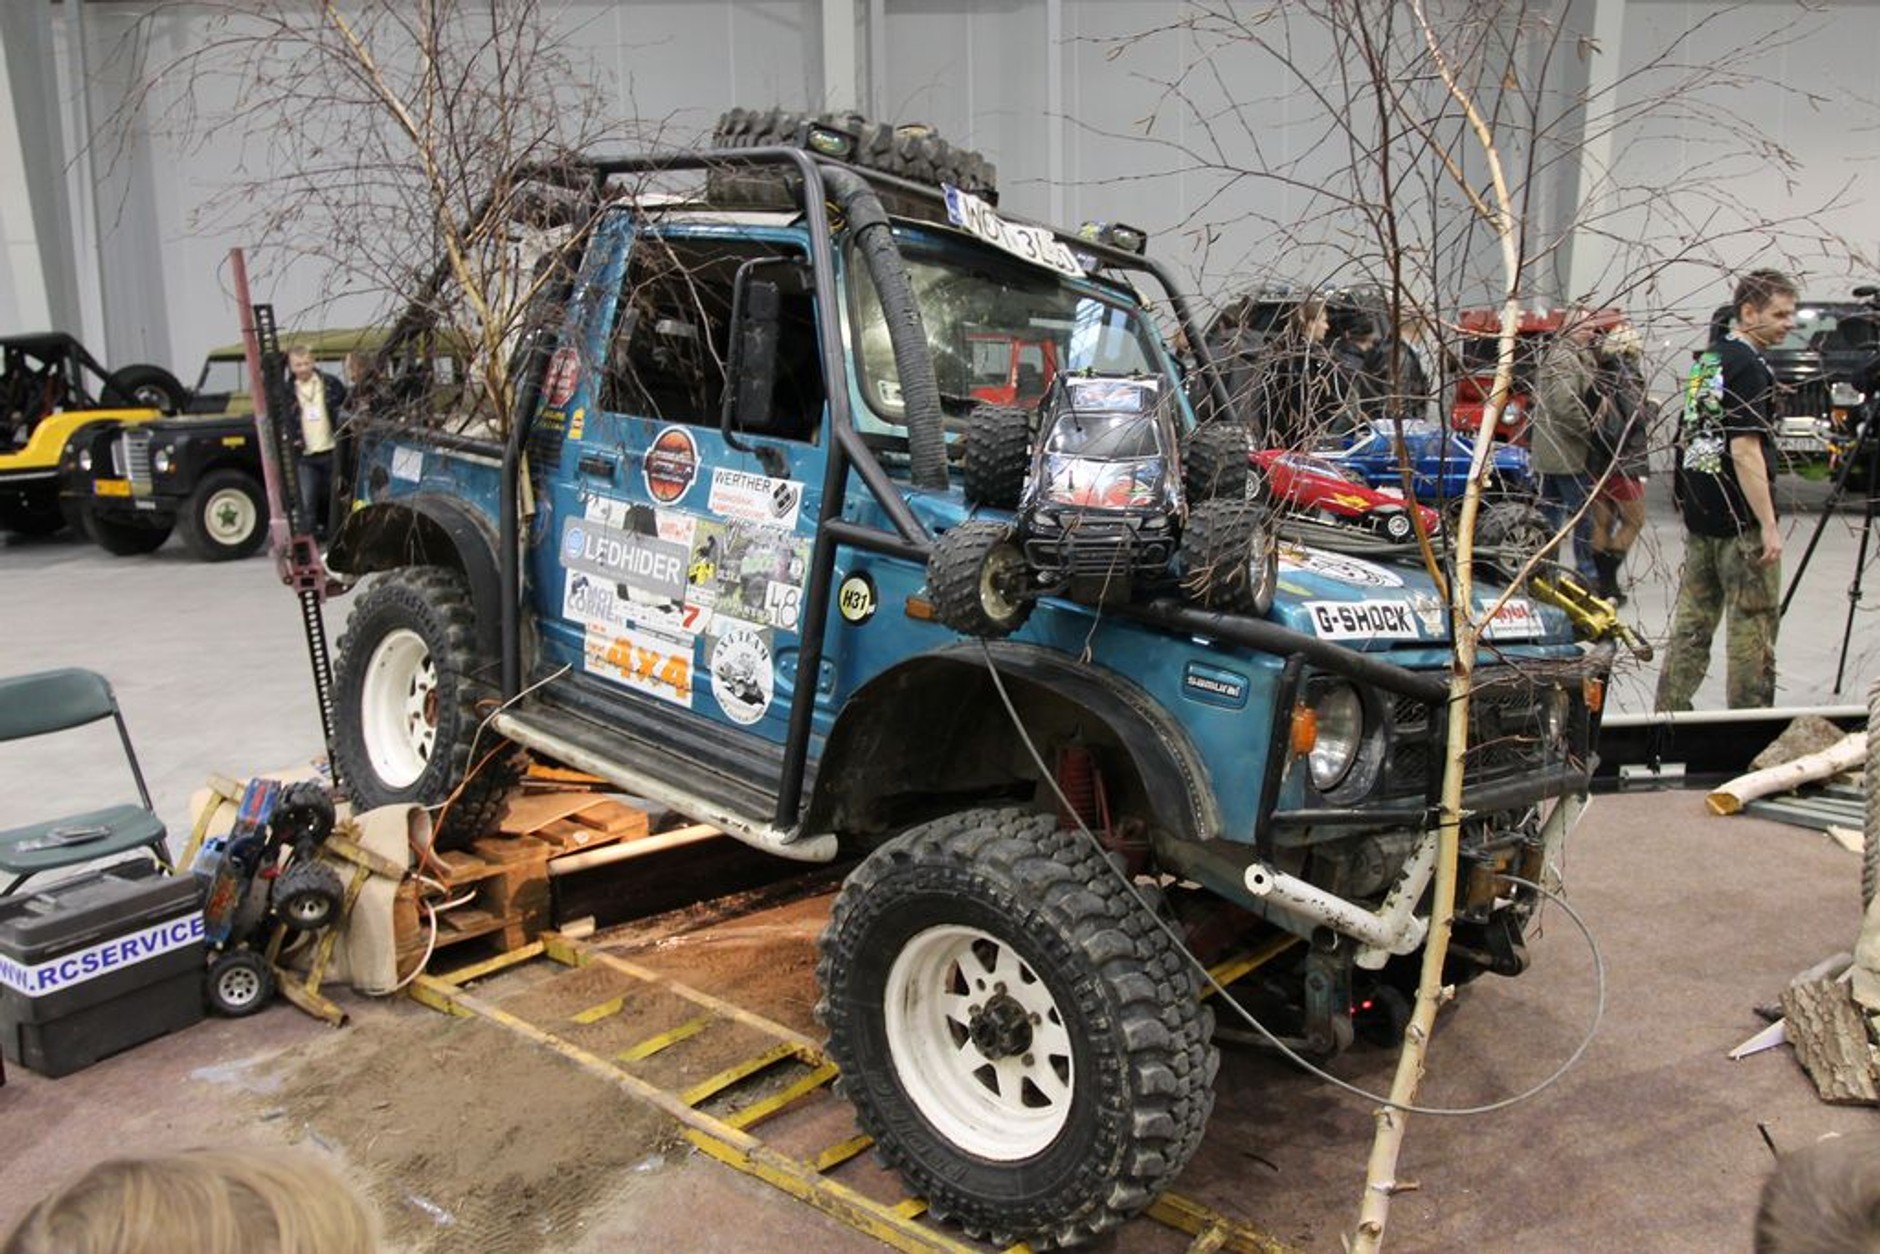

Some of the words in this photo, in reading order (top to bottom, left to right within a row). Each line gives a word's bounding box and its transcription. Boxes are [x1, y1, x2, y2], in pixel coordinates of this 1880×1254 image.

[714, 470, 772, 493] WERTHER
[586, 535, 681, 585] LEDHIDER
[843, 589, 867, 611] H31
[682, 605, 700, 628] 7
[1316, 605, 1412, 633] G-SHOCK
